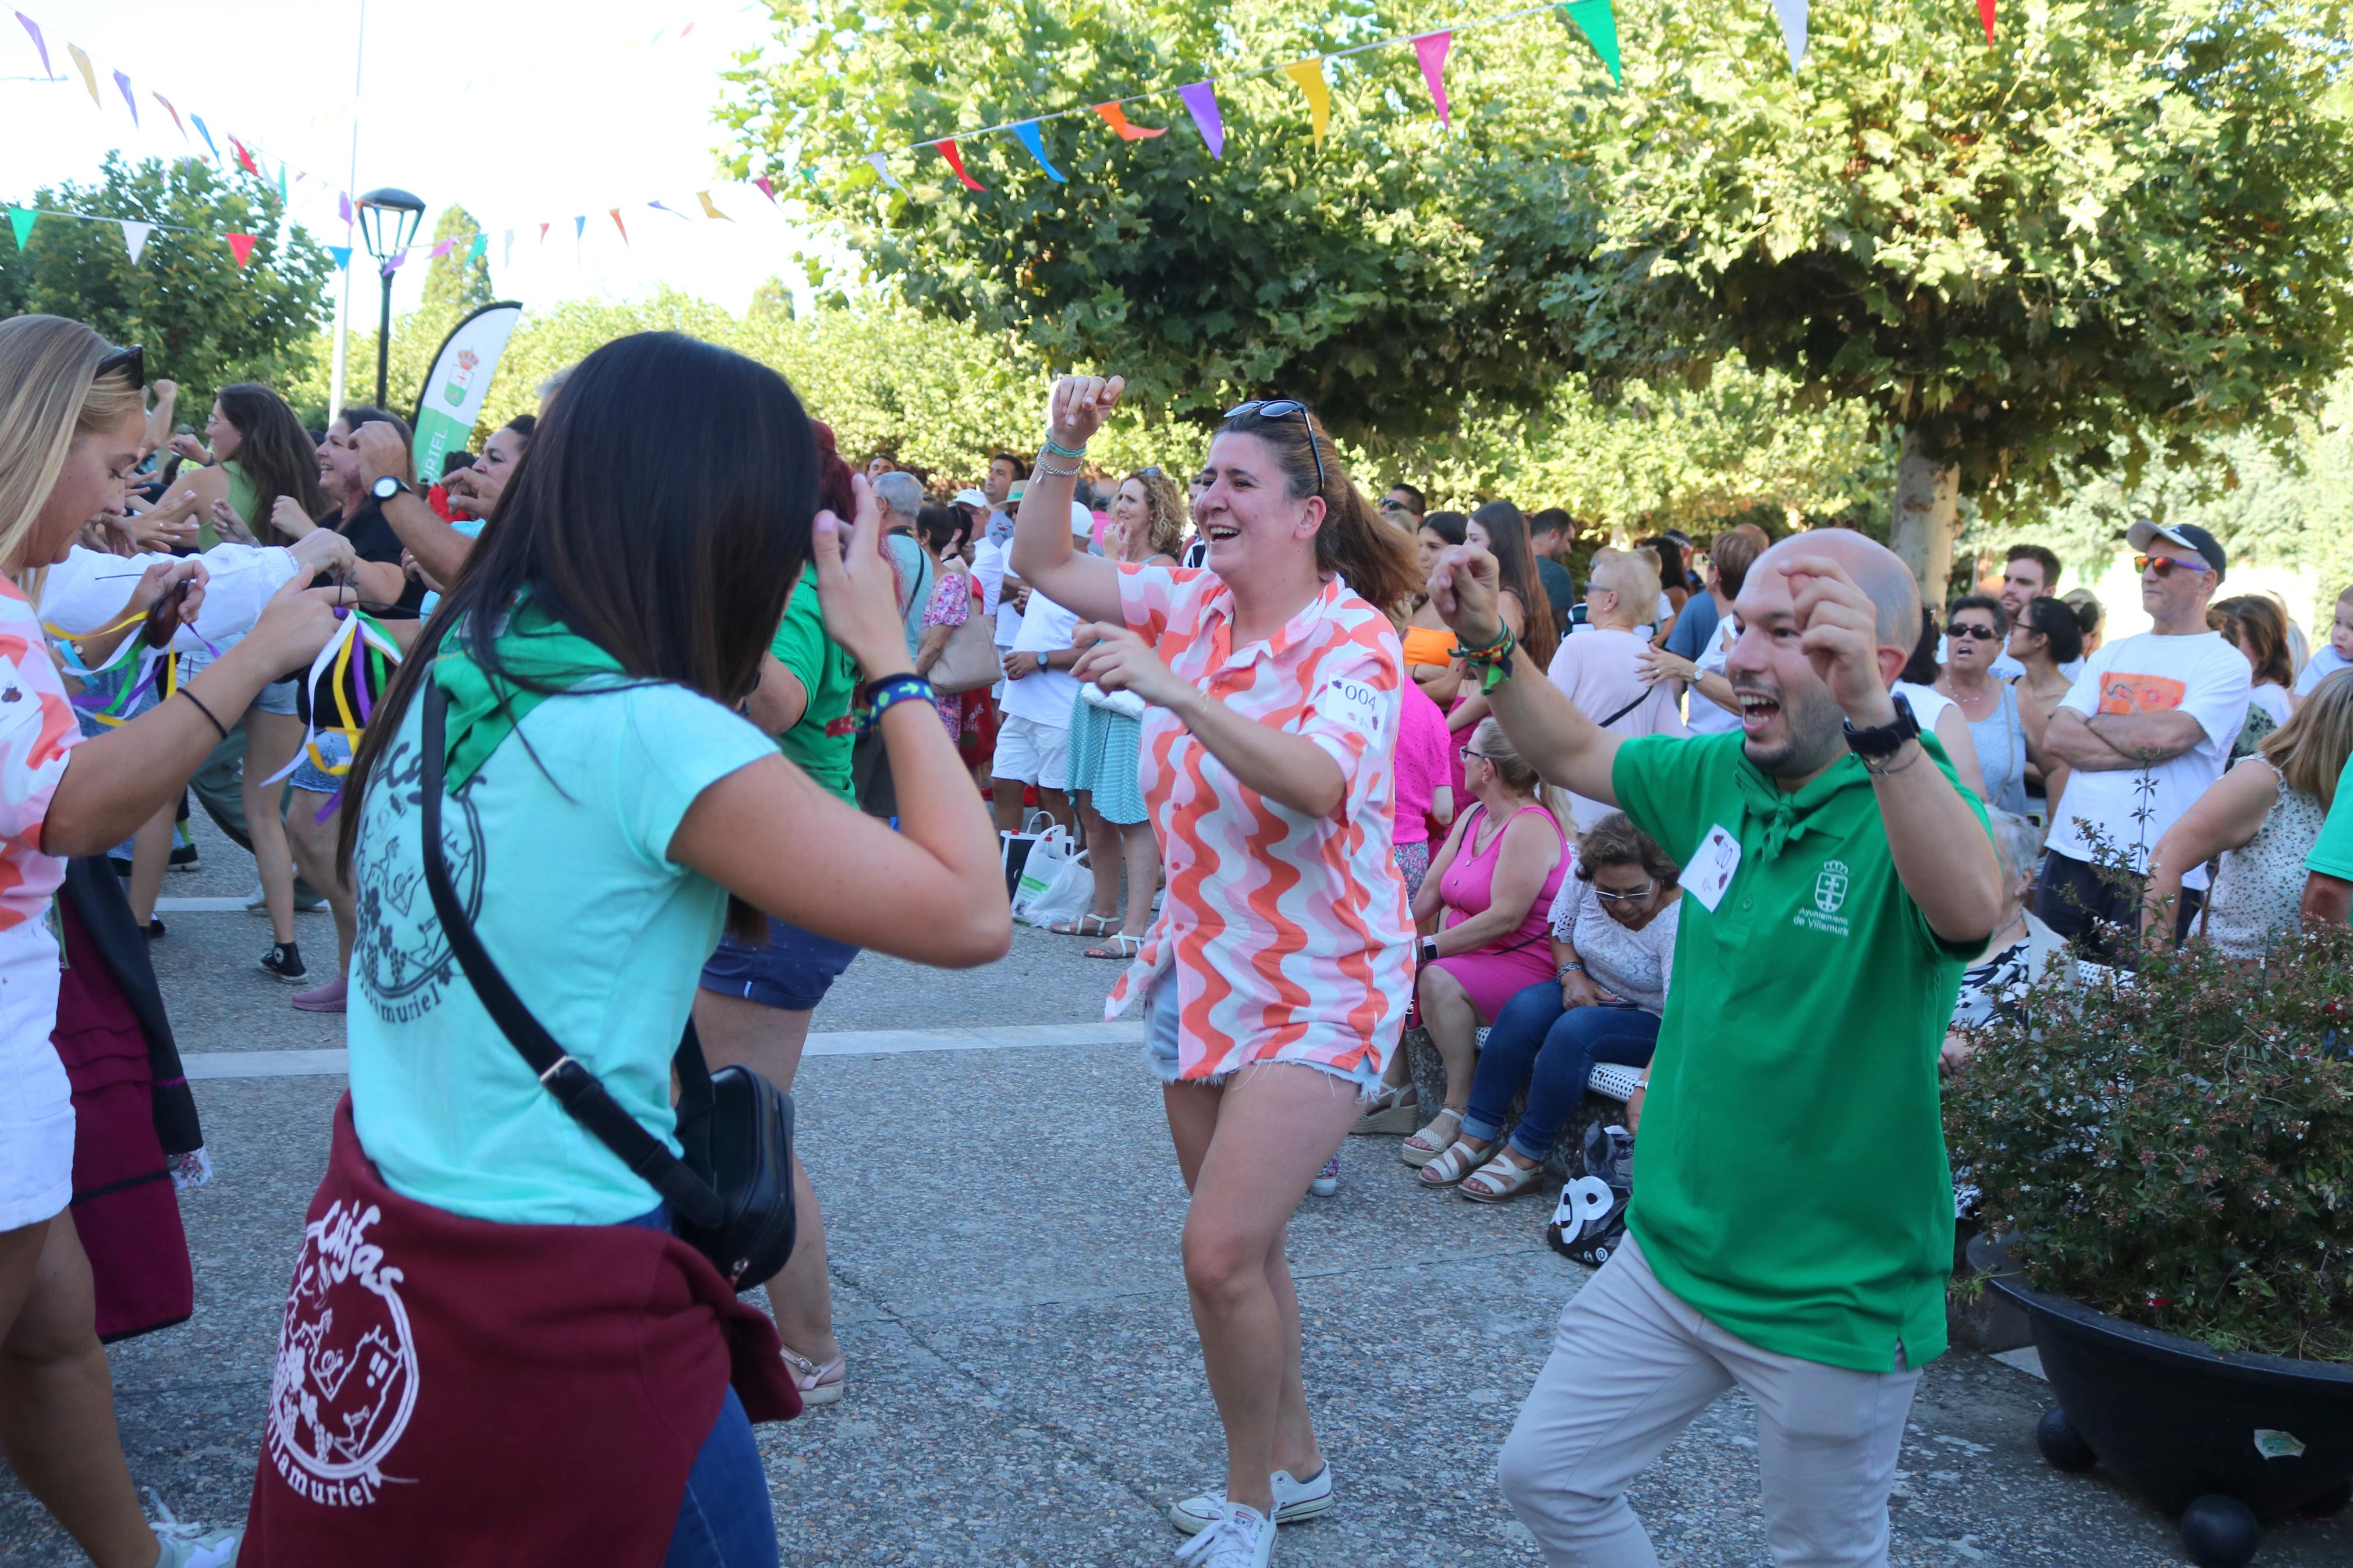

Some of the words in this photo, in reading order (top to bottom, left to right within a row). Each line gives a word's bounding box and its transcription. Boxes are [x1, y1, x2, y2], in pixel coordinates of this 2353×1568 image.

[1345, 685, 1376, 712] 004
[1794, 915, 1805, 926] de
[1808, 917, 1848, 937] Villamurie
